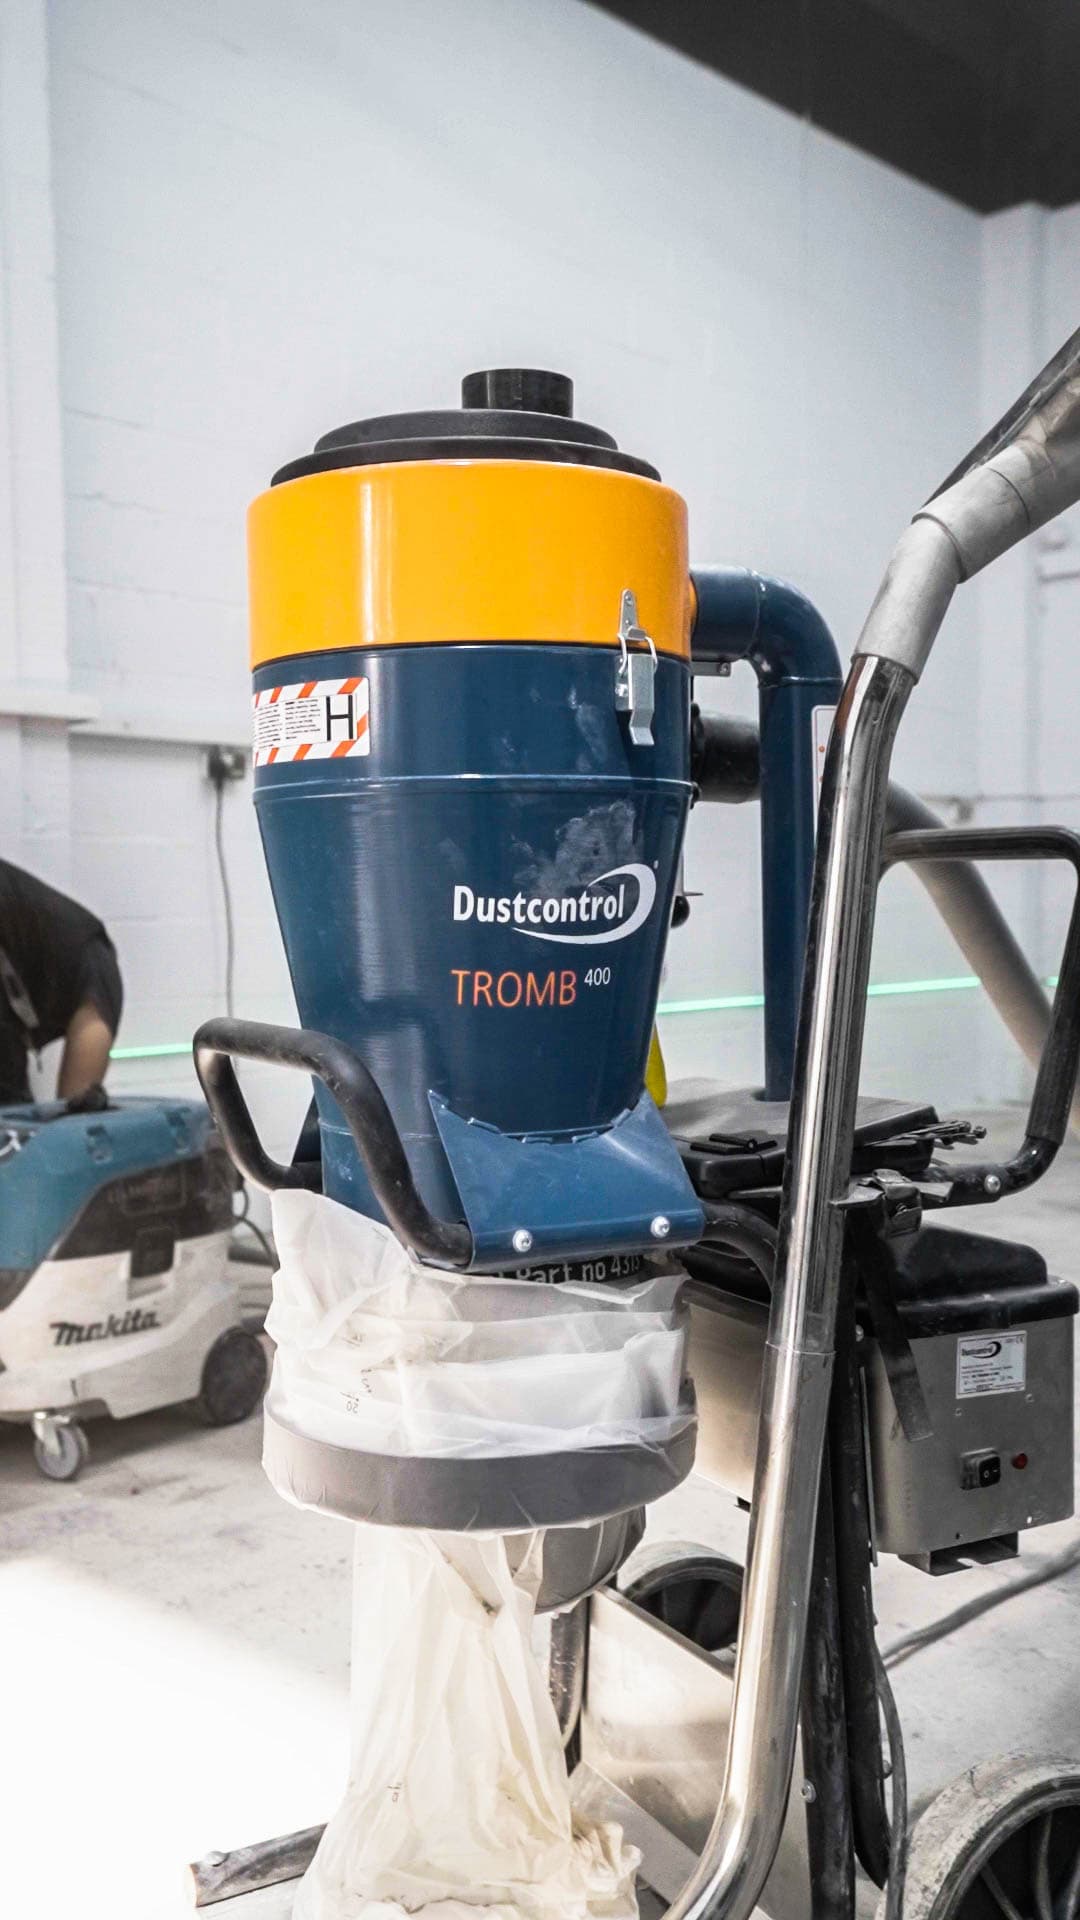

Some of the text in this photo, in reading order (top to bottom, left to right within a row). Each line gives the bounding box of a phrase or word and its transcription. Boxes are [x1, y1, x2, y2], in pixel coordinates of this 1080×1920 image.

[326, 694, 354, 741] H
[453, 884, 625, 924] Dustcontrol
[451, 967, 611, 1007] TROMB 400
[582, 1262, 606, 1282] no
